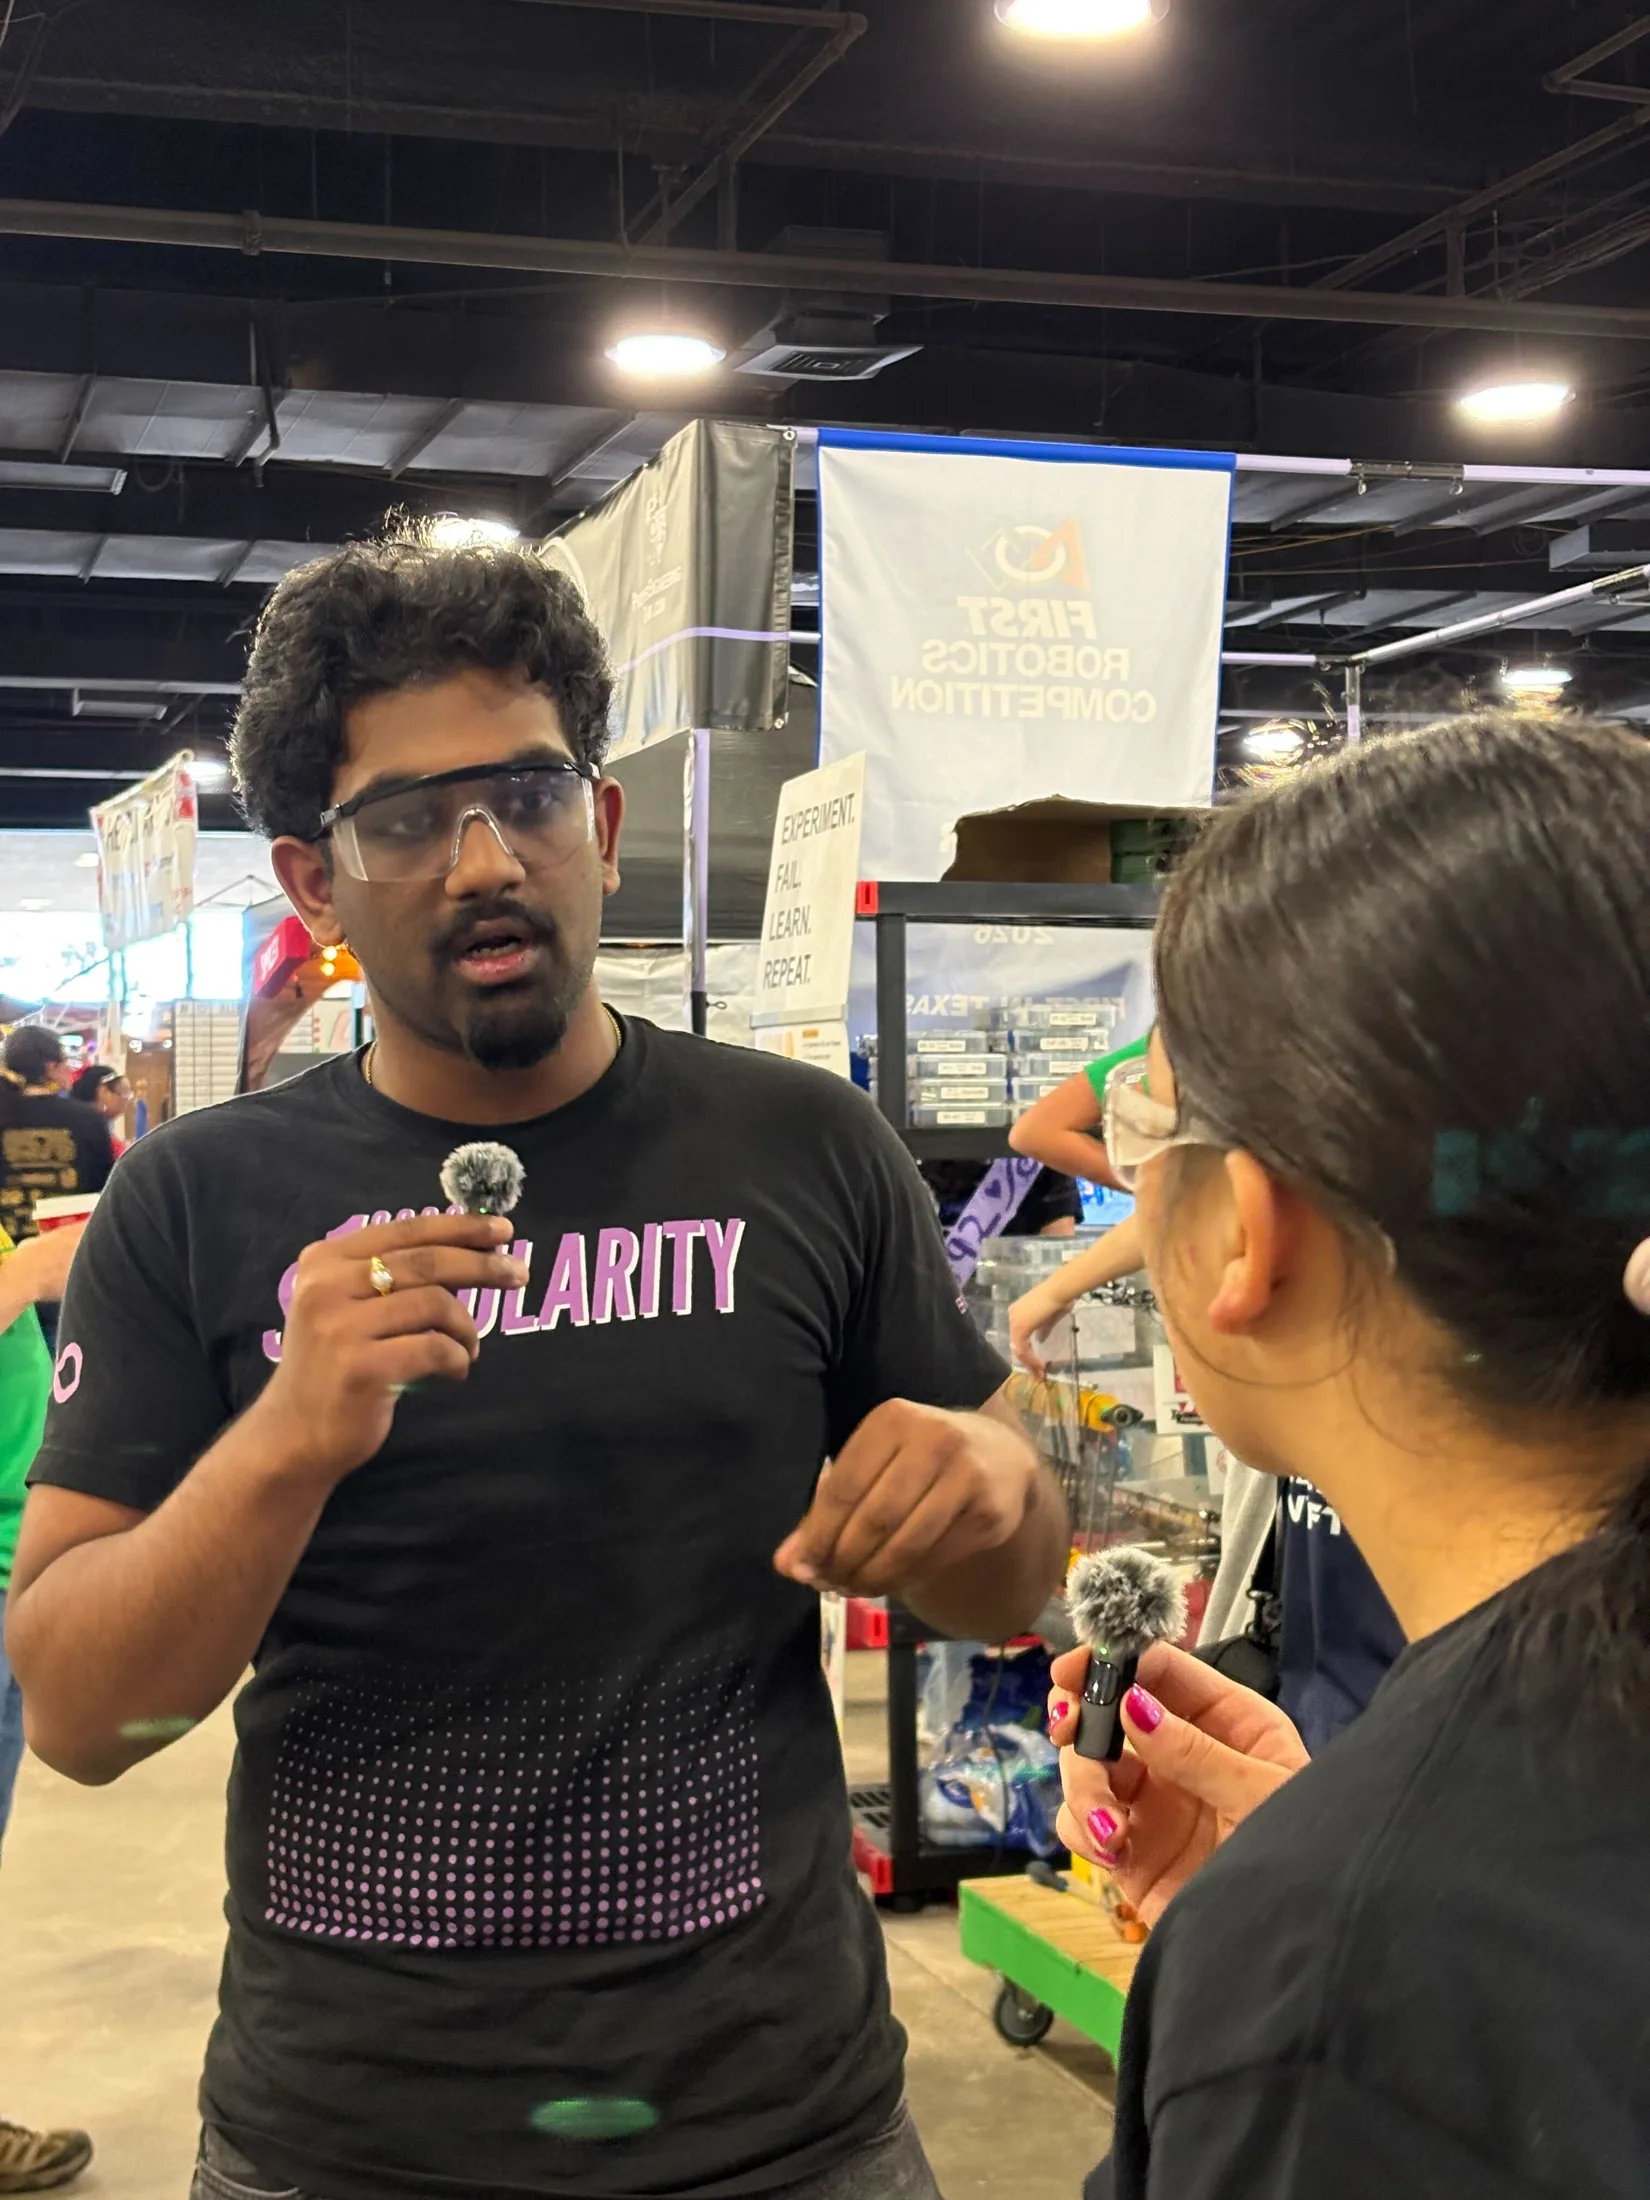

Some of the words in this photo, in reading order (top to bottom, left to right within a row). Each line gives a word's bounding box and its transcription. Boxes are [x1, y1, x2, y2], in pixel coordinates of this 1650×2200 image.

[781, 792, 856, 846] EXPERIMENT.
[774, 859, 802, 894] FAIL.
[768, 904, 812, 942] LEARN.
[762, 953, 812, 991] REPEAT.
